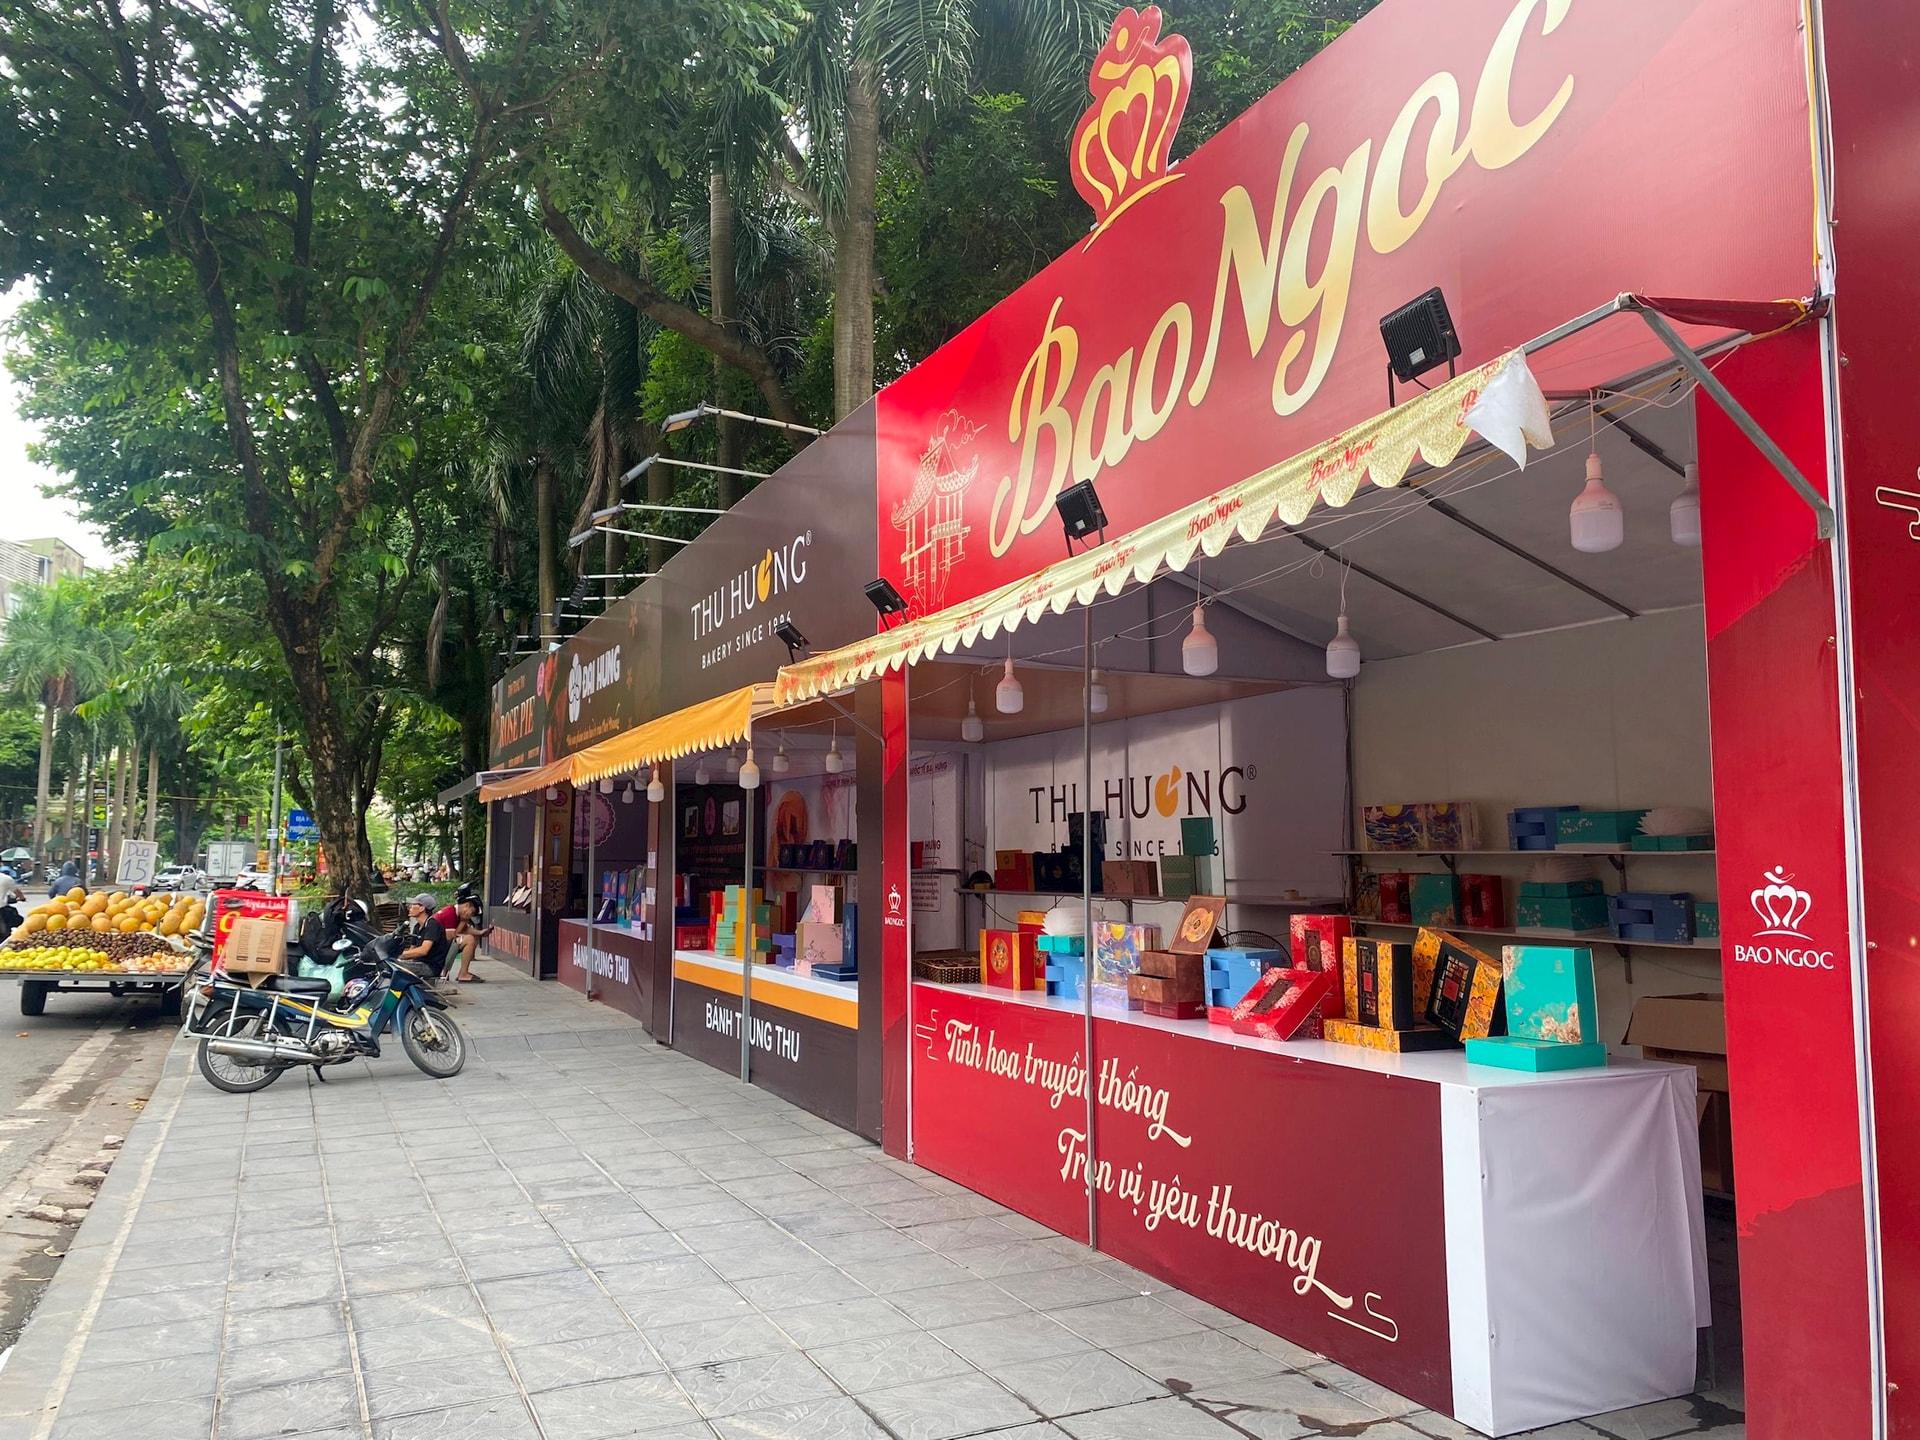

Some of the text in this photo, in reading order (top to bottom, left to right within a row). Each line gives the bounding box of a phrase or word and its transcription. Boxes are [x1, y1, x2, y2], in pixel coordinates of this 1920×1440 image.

[691, 586, 725, 641] THU
[702, 640, 732, 669] BAKERY
[736, 625, 763, 652] SINCE
[121, 859, 147, 882] 15
[1115, 840, 1165, 857] SINCE
[591, 948, 613, 979] TRUNG
[614, 955, 629, 985] THU
[1734, 944, 1834, 970] BAO NGOC
[706, 998, 800, 1063] BÁNH TUNG THU
[985, 1030, 1022, 1081] hoa
[1024, 1042, 1088, 1109] truyền
[1098, 1057, 1192, 1148] thống
[1118, 1161, 1145, 1217] vị
[1145, 1174, 1201, 1232] yêu
[1206, 1184, 1354, 1309] thương
